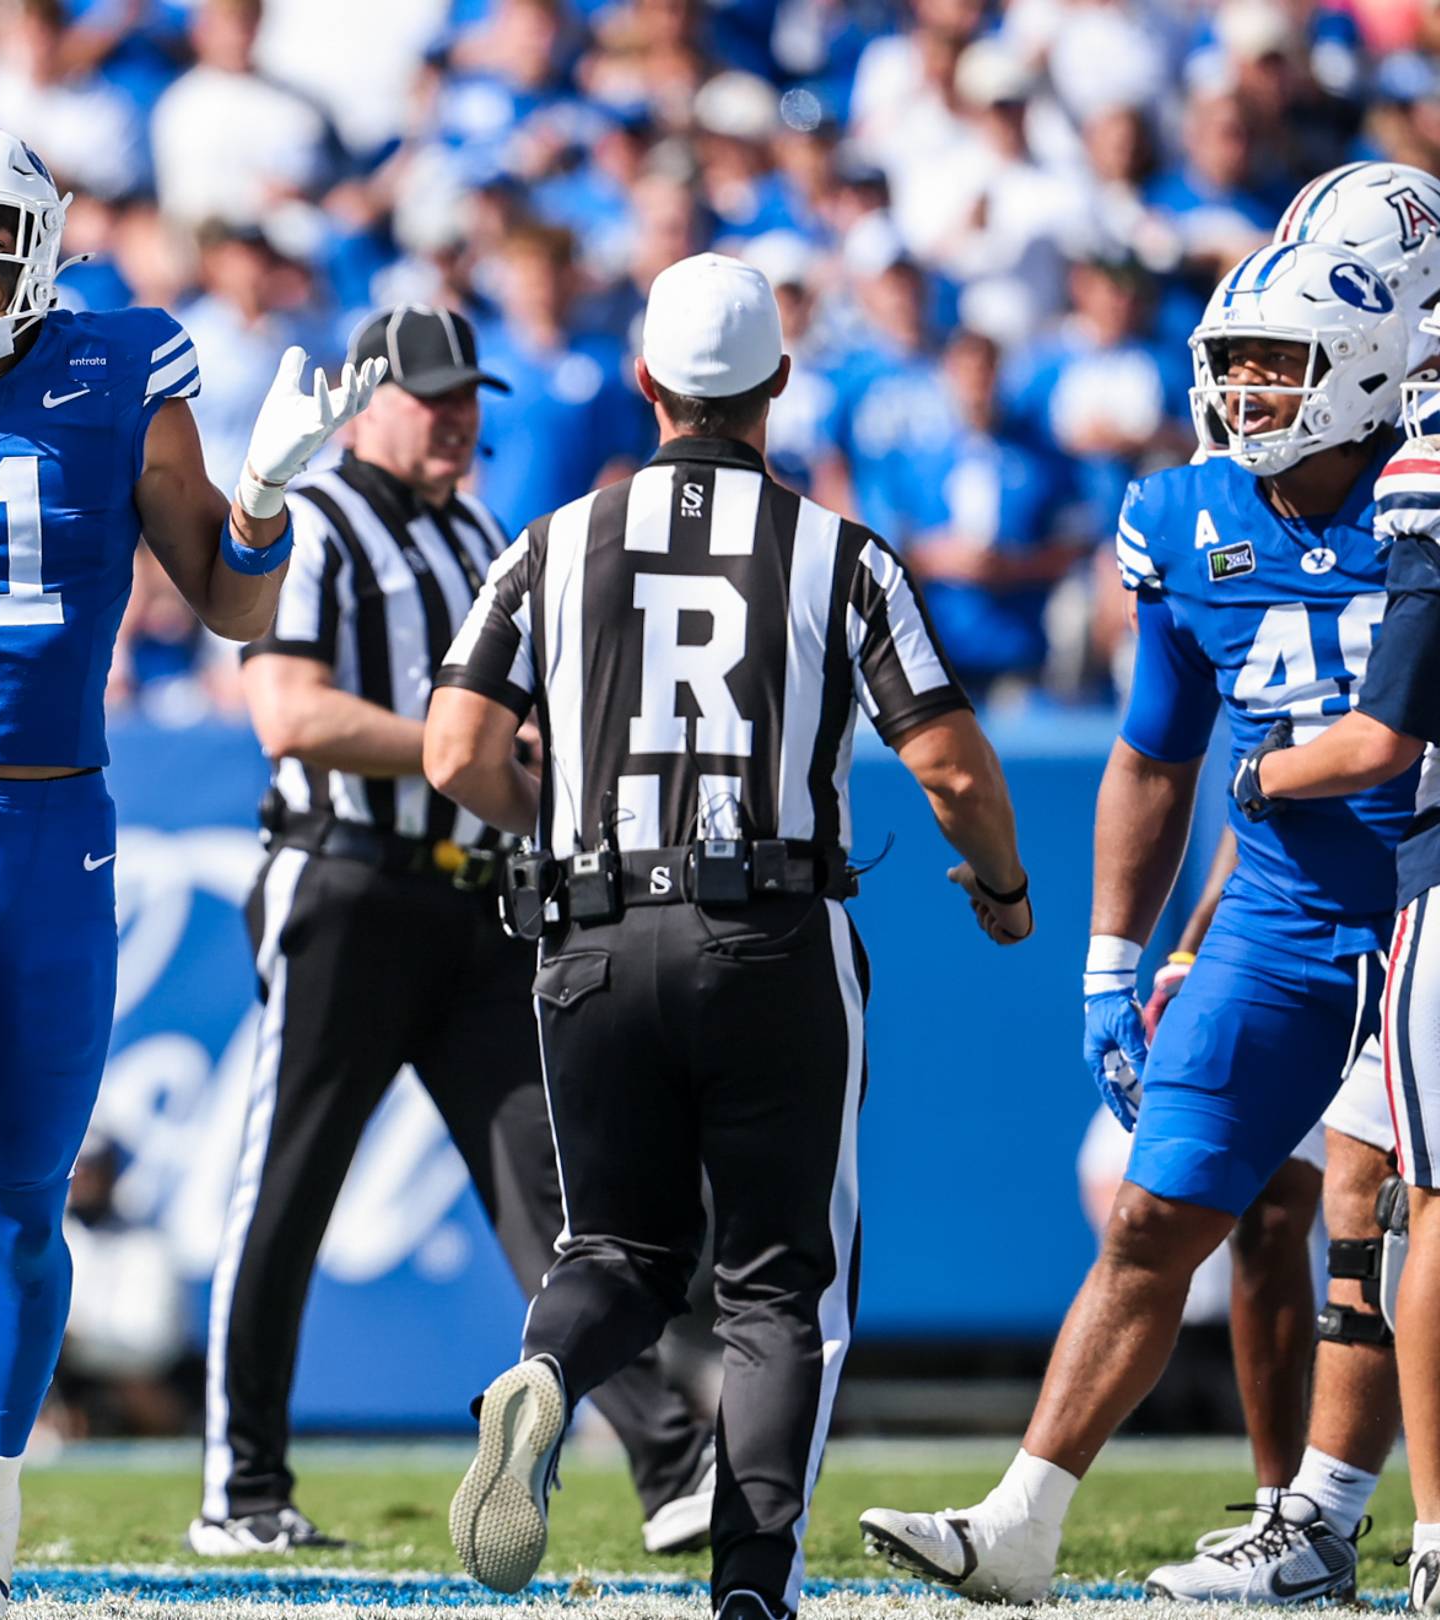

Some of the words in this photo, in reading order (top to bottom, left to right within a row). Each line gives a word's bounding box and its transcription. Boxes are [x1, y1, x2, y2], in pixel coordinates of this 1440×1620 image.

[1385, 187, 1440, 251] A
[1335, 265, 1383, 308] Y
[69, 357, 107, 366] entrata
[1195, 509, 1220, 549] A
[629, 573, 753, 757] R
[650, 866, 673, 895] S
